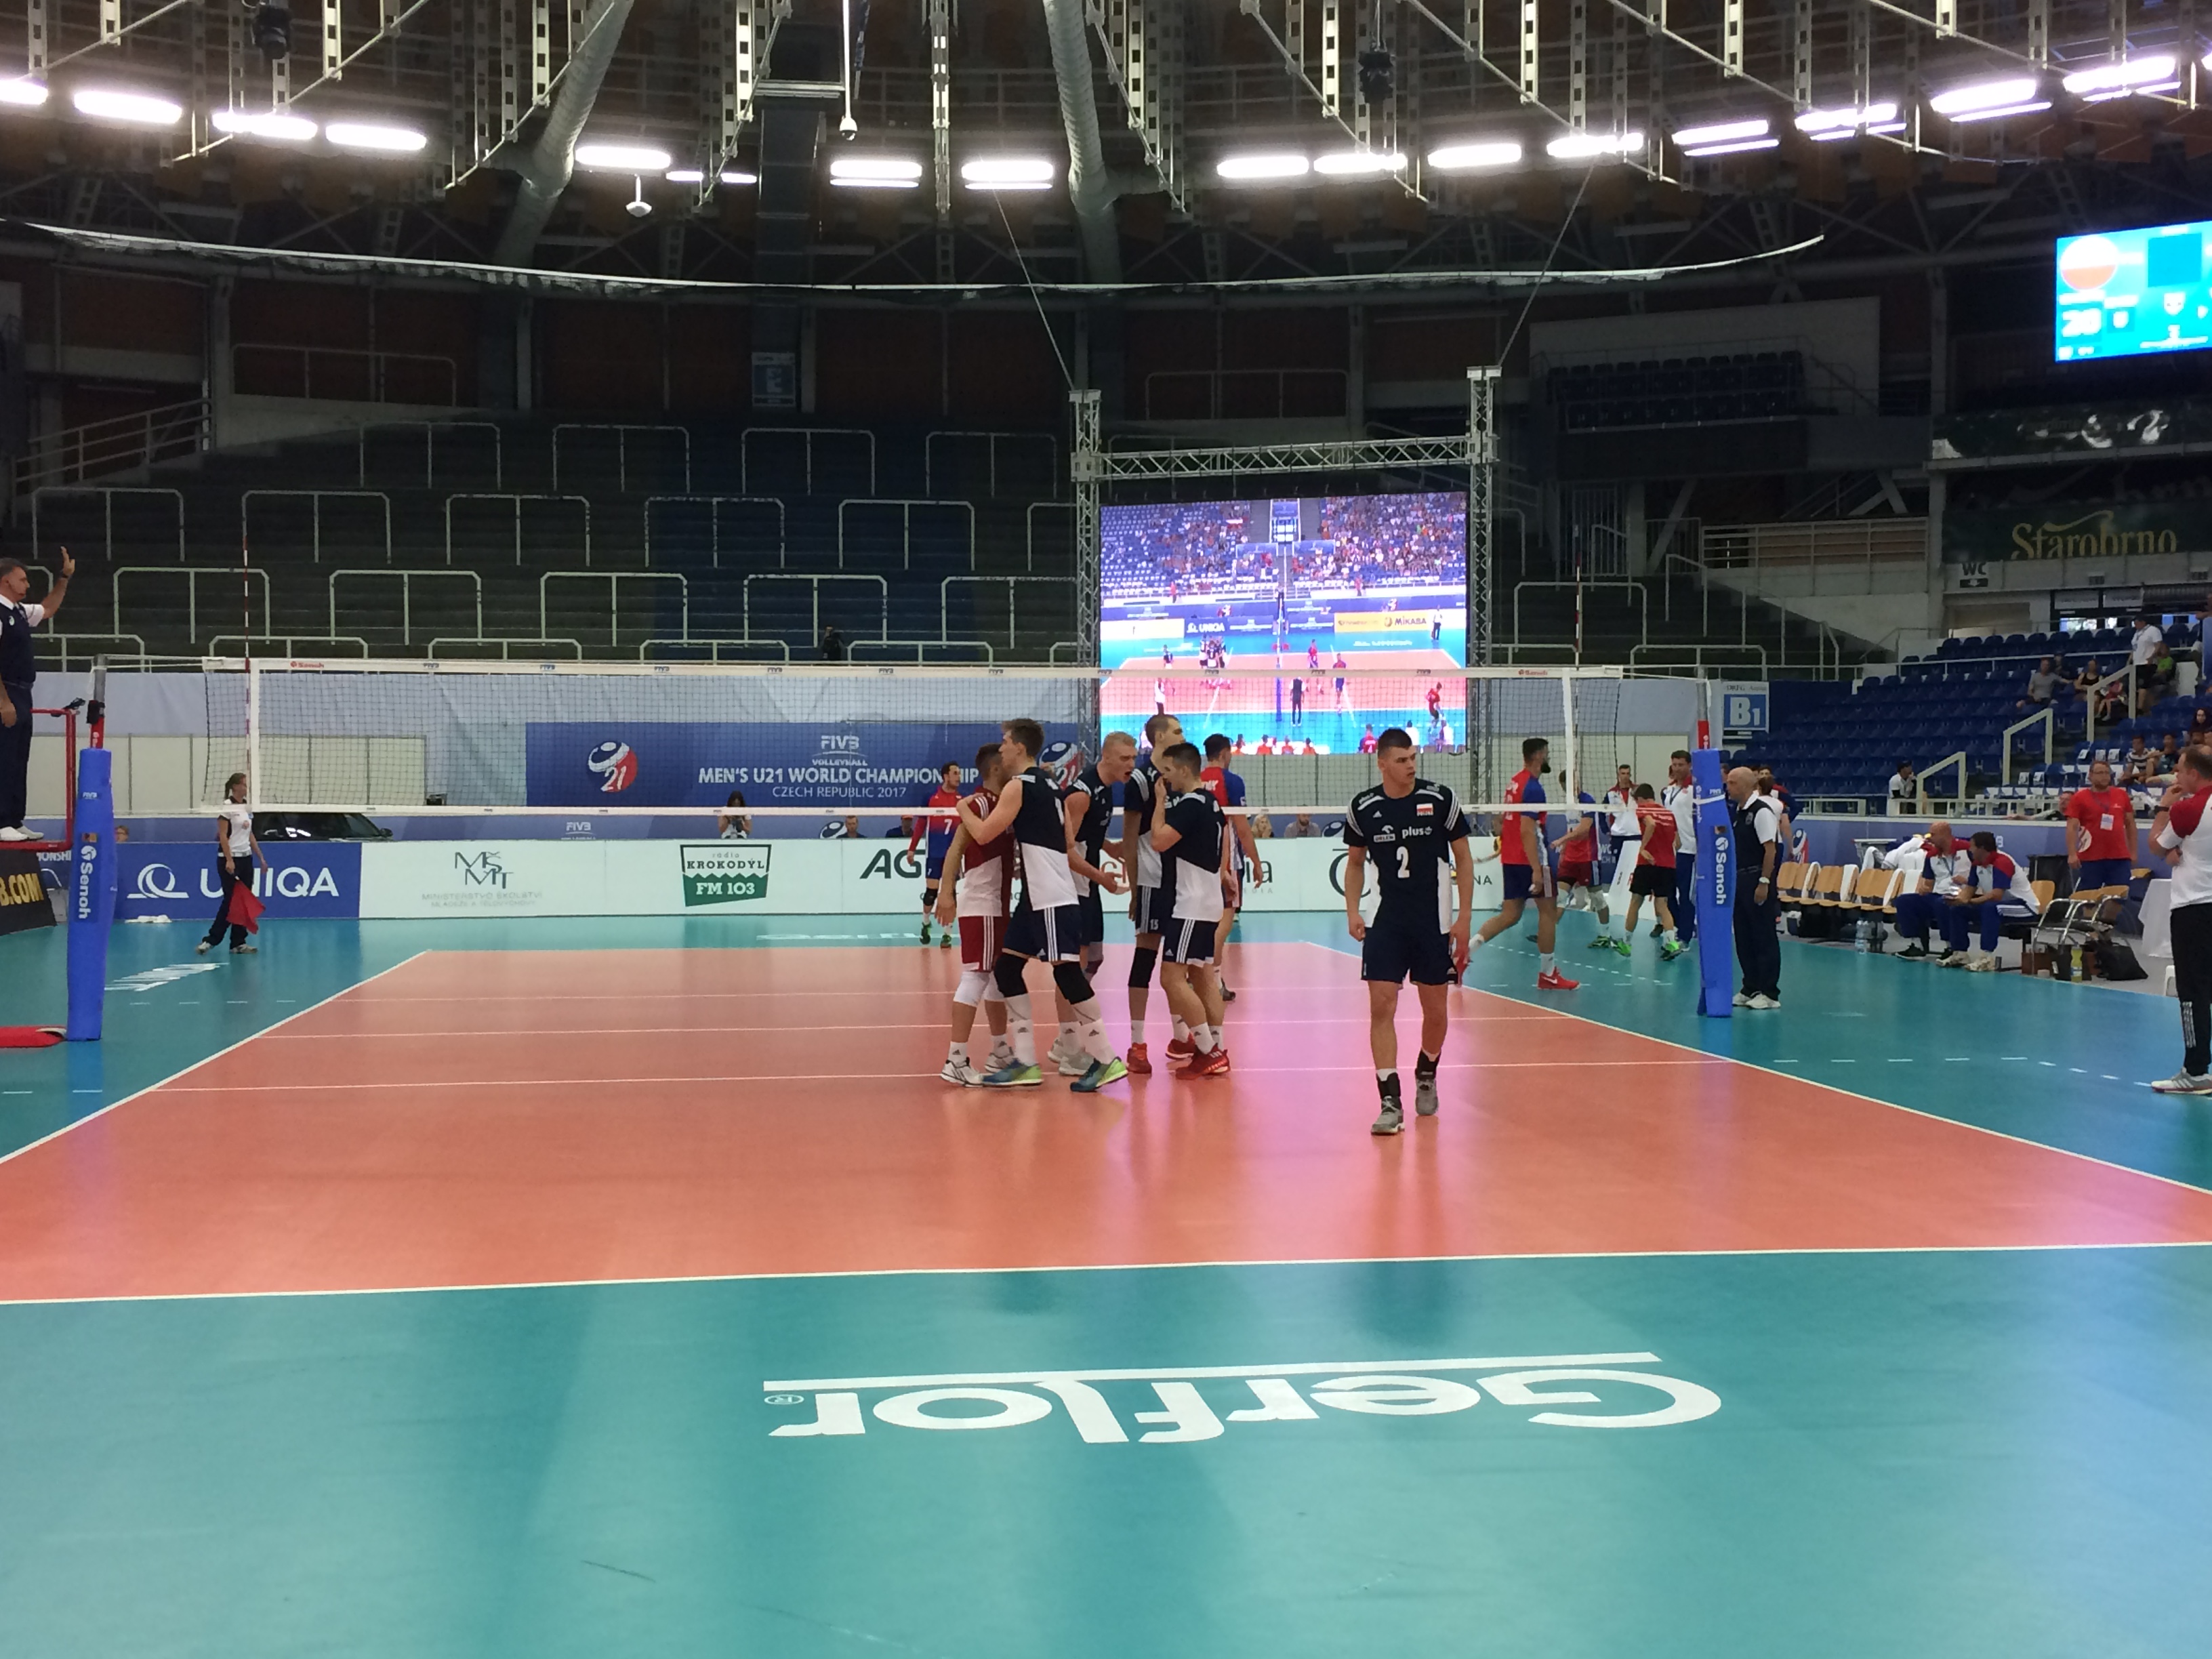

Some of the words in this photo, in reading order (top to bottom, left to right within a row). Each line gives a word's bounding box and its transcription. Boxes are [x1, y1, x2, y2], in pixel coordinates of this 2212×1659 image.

[2011, 510, 2177, 560] Starobrno
[1962, 563, 1987, 576] WC
[1730, 697, 1761, 726] B1
[821, 735, 859, 750] FIVB
[600, 766, 627, 792] 21
[698, 768, 748, 783] MEN'S
[753, 768, 783, 783] U21
[787, 768, 851, 783] WORLD
[855, 768, 979, 784] CHAMPIONHIP
[773, 786, 813, 798] CZECH
[817, 786, 874, 798] REPUBLIC
[878, 787, 907, 798] 2017
[567, 822, 591, 831] FIVB
[944, 819, 953, 835] 7
[1401, 826, 1424, 839] plus
[687, 858, 764, 869] KROKODÝL
[1396, 846, 1410, 878] 2
[201, 866, 340, 899] UIQA
[1715, 852, 1727, 905] Senoh
[78, 861, 94, 919] Senoh
[696, 882, 722, 895] FM
[727, 882, 755, 895] 103
[769, 1368, 1722, 1444] Gerflor
